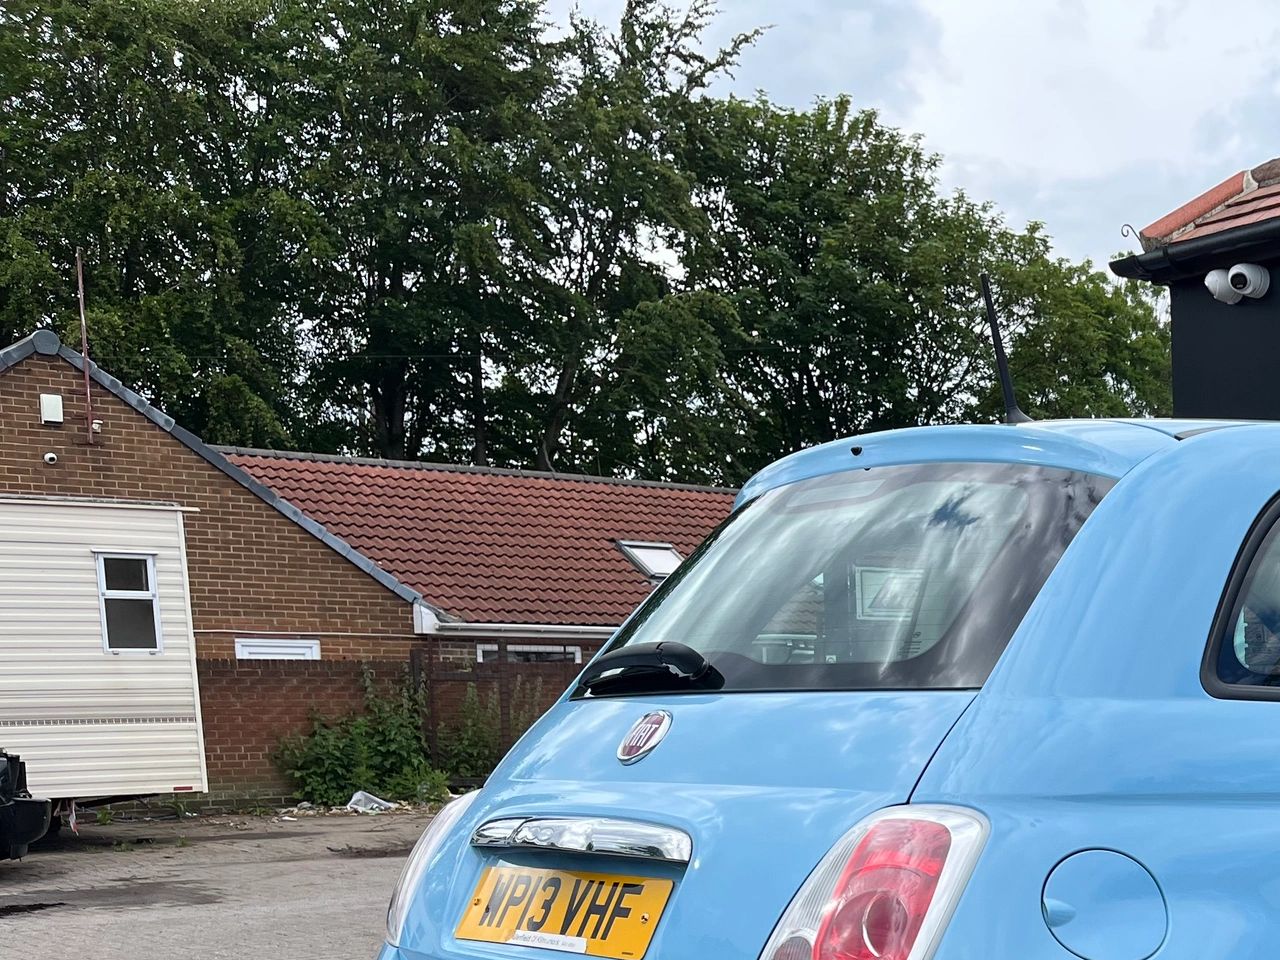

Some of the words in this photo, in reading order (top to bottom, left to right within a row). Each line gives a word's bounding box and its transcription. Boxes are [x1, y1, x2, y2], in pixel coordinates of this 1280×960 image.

[624, 722, 660, 747] FIAT
[478, 873, 562, 932] WP13
[560, 878, 646, 941] VHF
